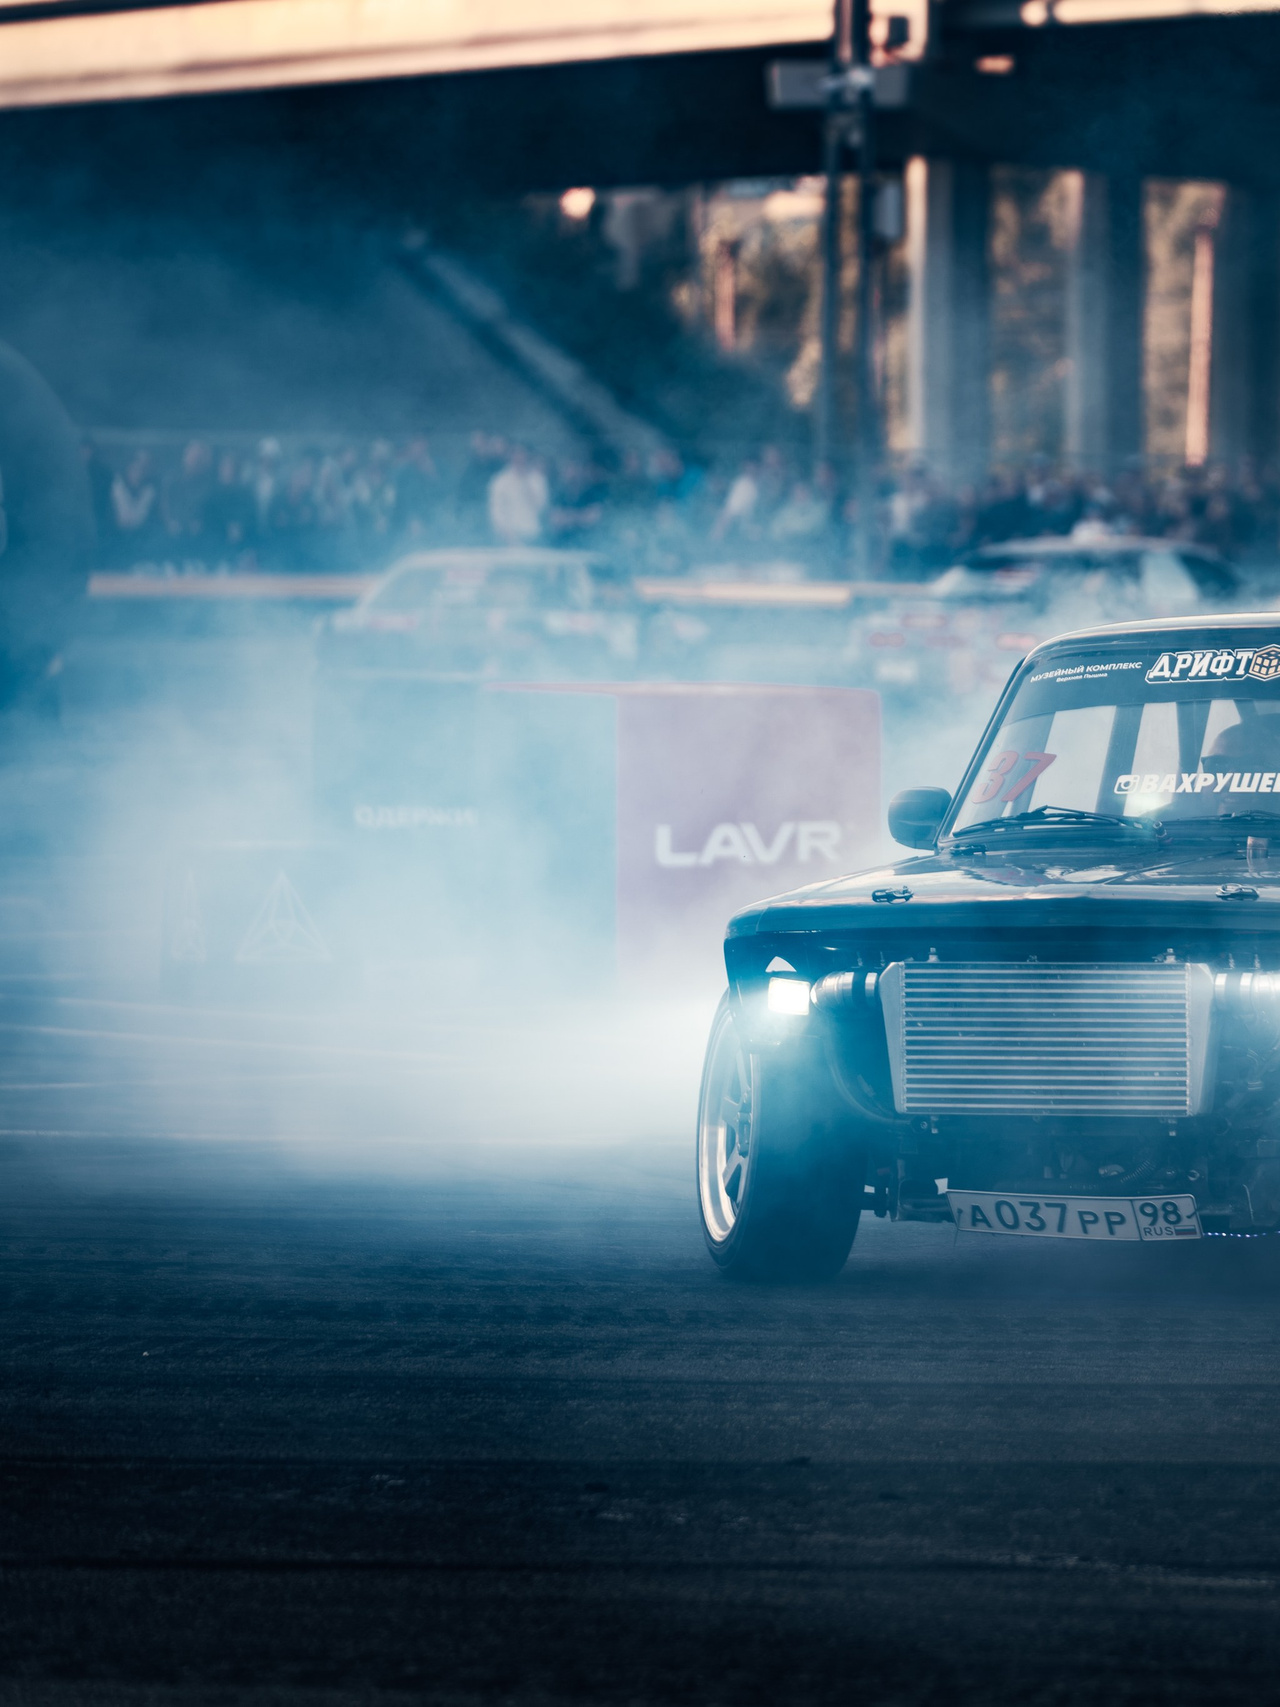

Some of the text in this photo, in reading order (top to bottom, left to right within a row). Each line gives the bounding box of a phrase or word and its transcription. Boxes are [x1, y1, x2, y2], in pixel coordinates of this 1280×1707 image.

[1030, 661, 1143, 683] МУЗЕЙНЫЙ КОМПЛЕКС
[1147, 649, 1255, 680] ДРИФТ
[971, 750, 1057, 804] 37
[655, 820, 842, 868] LAVR
[1139, 1201, 1182, 1226] 98
[1142, 1225, 1174, 1237] RUS
